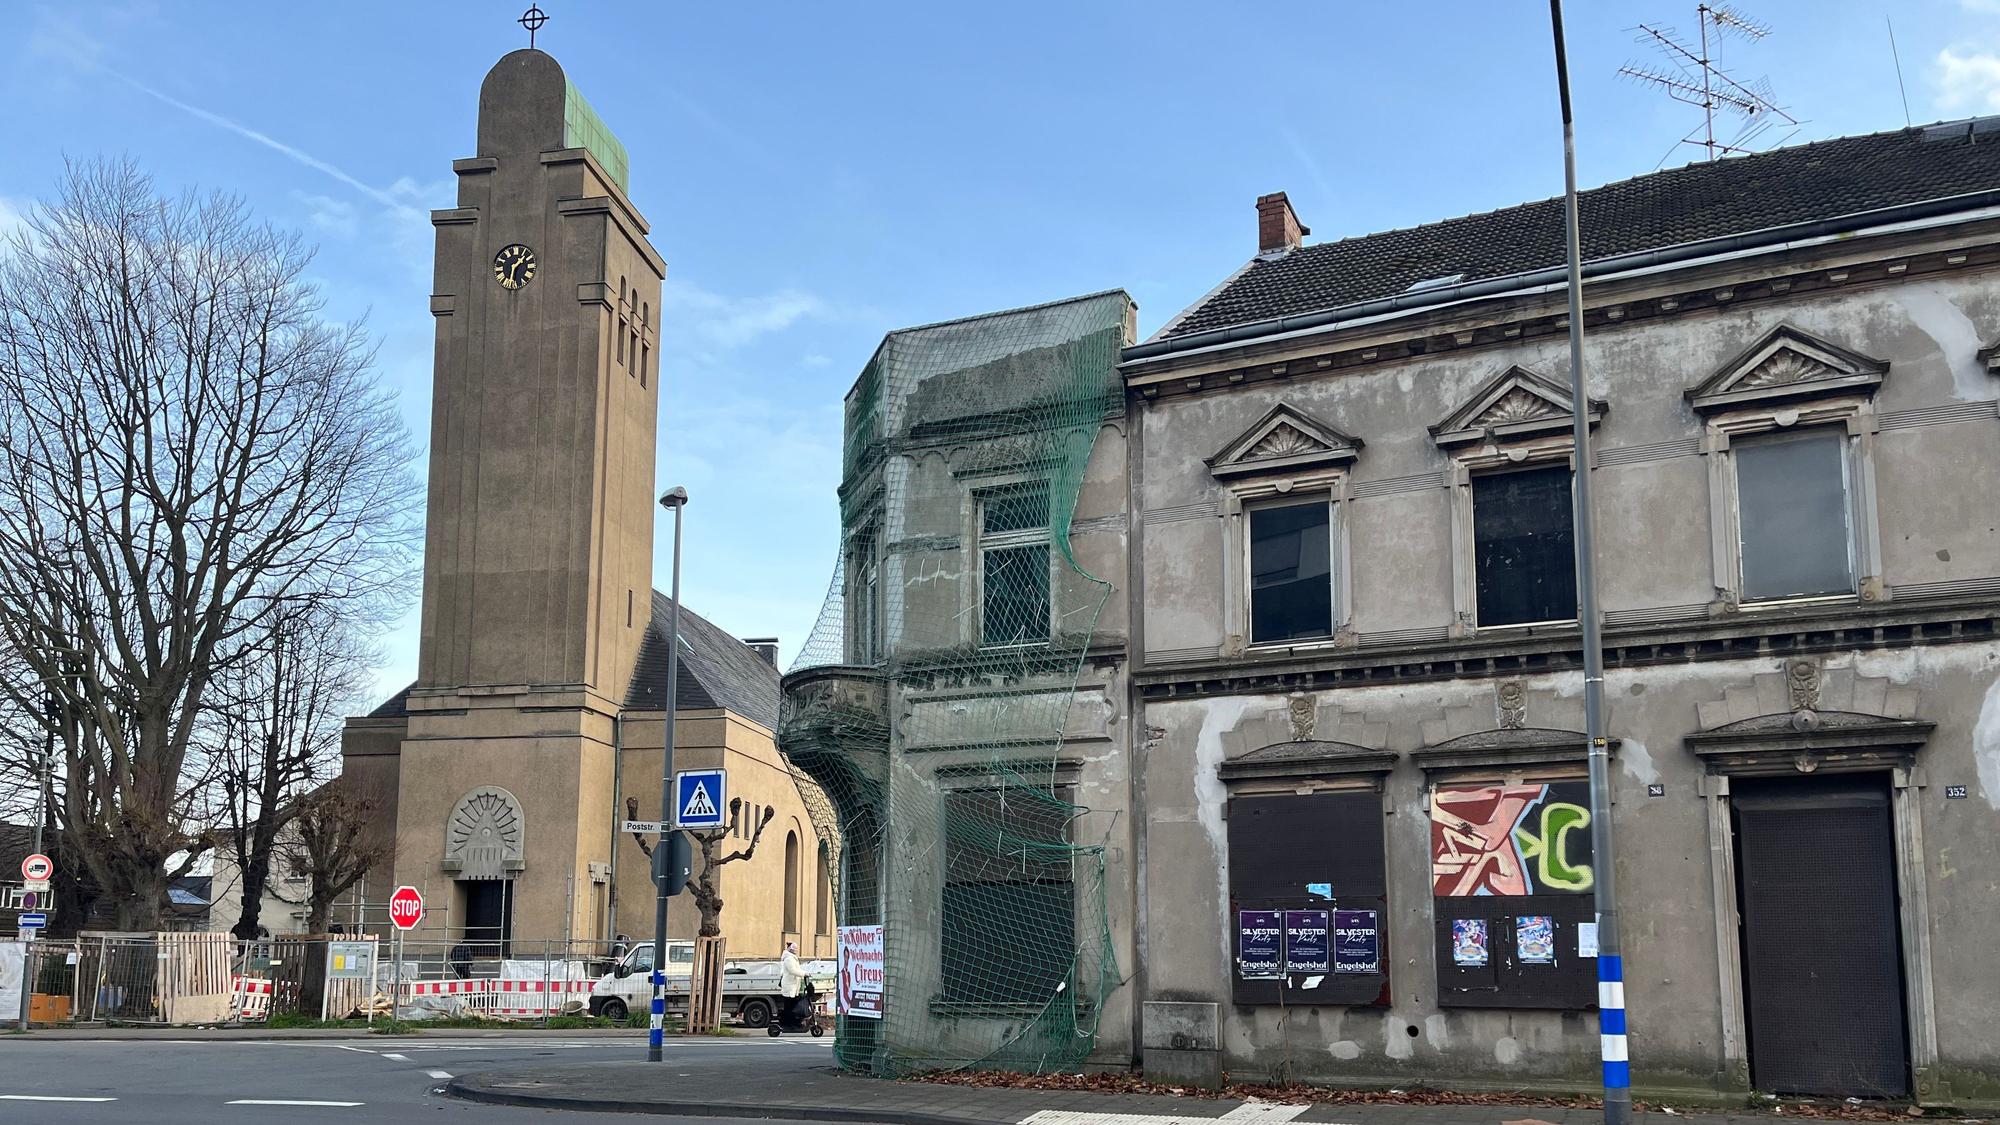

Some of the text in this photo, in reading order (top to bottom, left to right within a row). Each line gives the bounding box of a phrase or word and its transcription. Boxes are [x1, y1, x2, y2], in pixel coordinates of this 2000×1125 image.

[1947, 787, 1966, 797] 352
[626, 822, 655, 831] Poststr.
[393, 899, 420, 917] STOP
[850, 948, 883, 962] Weihnachts
[1288, 960, 1327, 969] Engelshof
[1336, 961, 1377, 971] Engelshof
[854, 963, 882, 985] Circus
